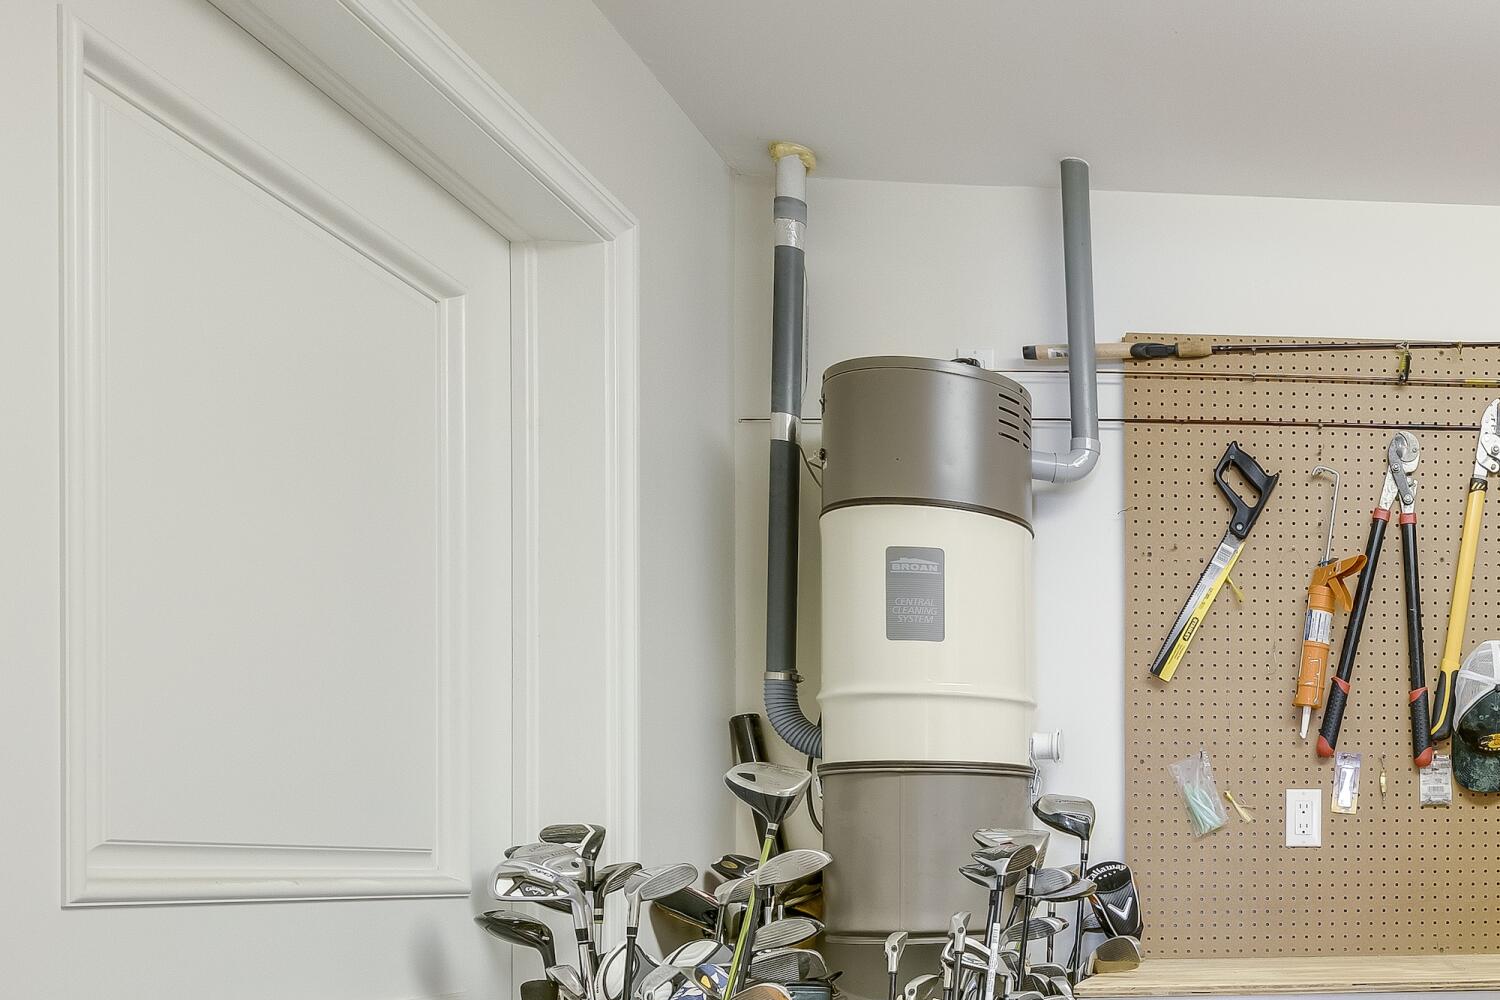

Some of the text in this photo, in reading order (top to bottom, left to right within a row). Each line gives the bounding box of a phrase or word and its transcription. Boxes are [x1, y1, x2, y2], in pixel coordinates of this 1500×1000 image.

[892, 563, 938, 572] BROAN
[895, 597, 934, 607] CENTRAL
[892, 606, 937, 616] CLEANING
[897, 615, 934, 624] SYSTEM
